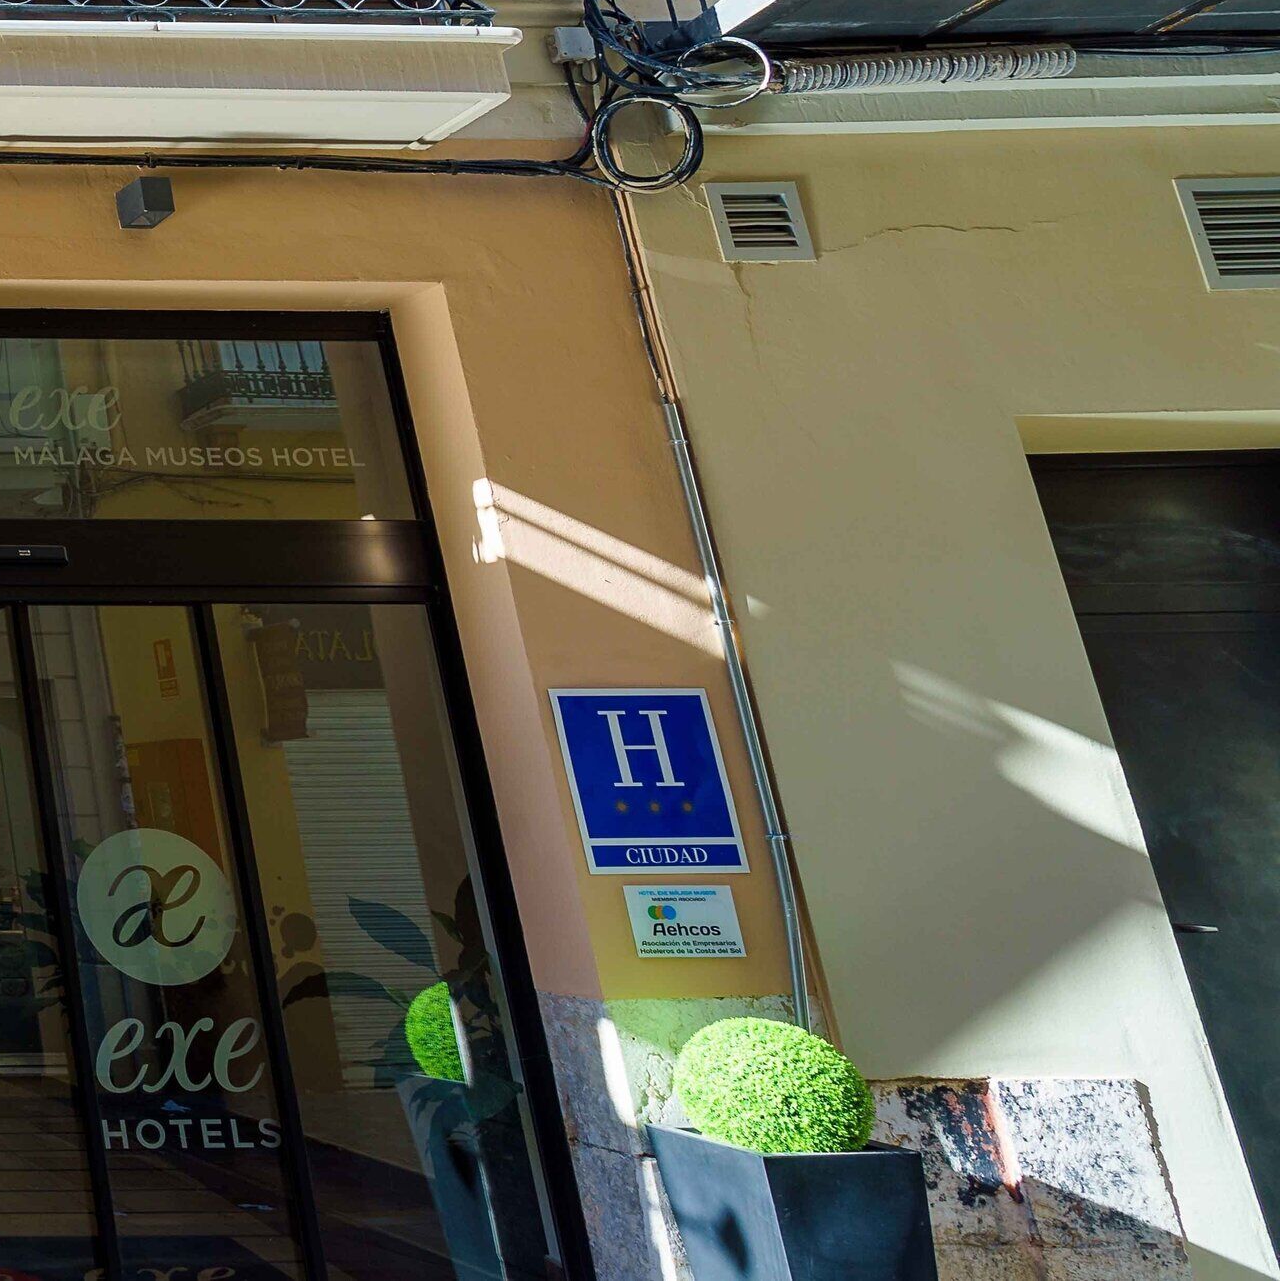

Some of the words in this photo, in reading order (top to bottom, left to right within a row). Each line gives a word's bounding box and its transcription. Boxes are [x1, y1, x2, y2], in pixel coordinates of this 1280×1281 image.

[9, 381, 123, 431] exe
[13, 439, 137, 467] MÁLAGA
[146, 446, 264, 468] MUSEOS
[271, 446, 366, 469] HOTEL
[596, 709, 686, 787] H
[625, 847, 709, 864] CIUDAD
[652, 922, 721, 936] Aehcos
[95, 1016, 267, 1094] exe
[100, 1118, 283, 1151] HOTELS
